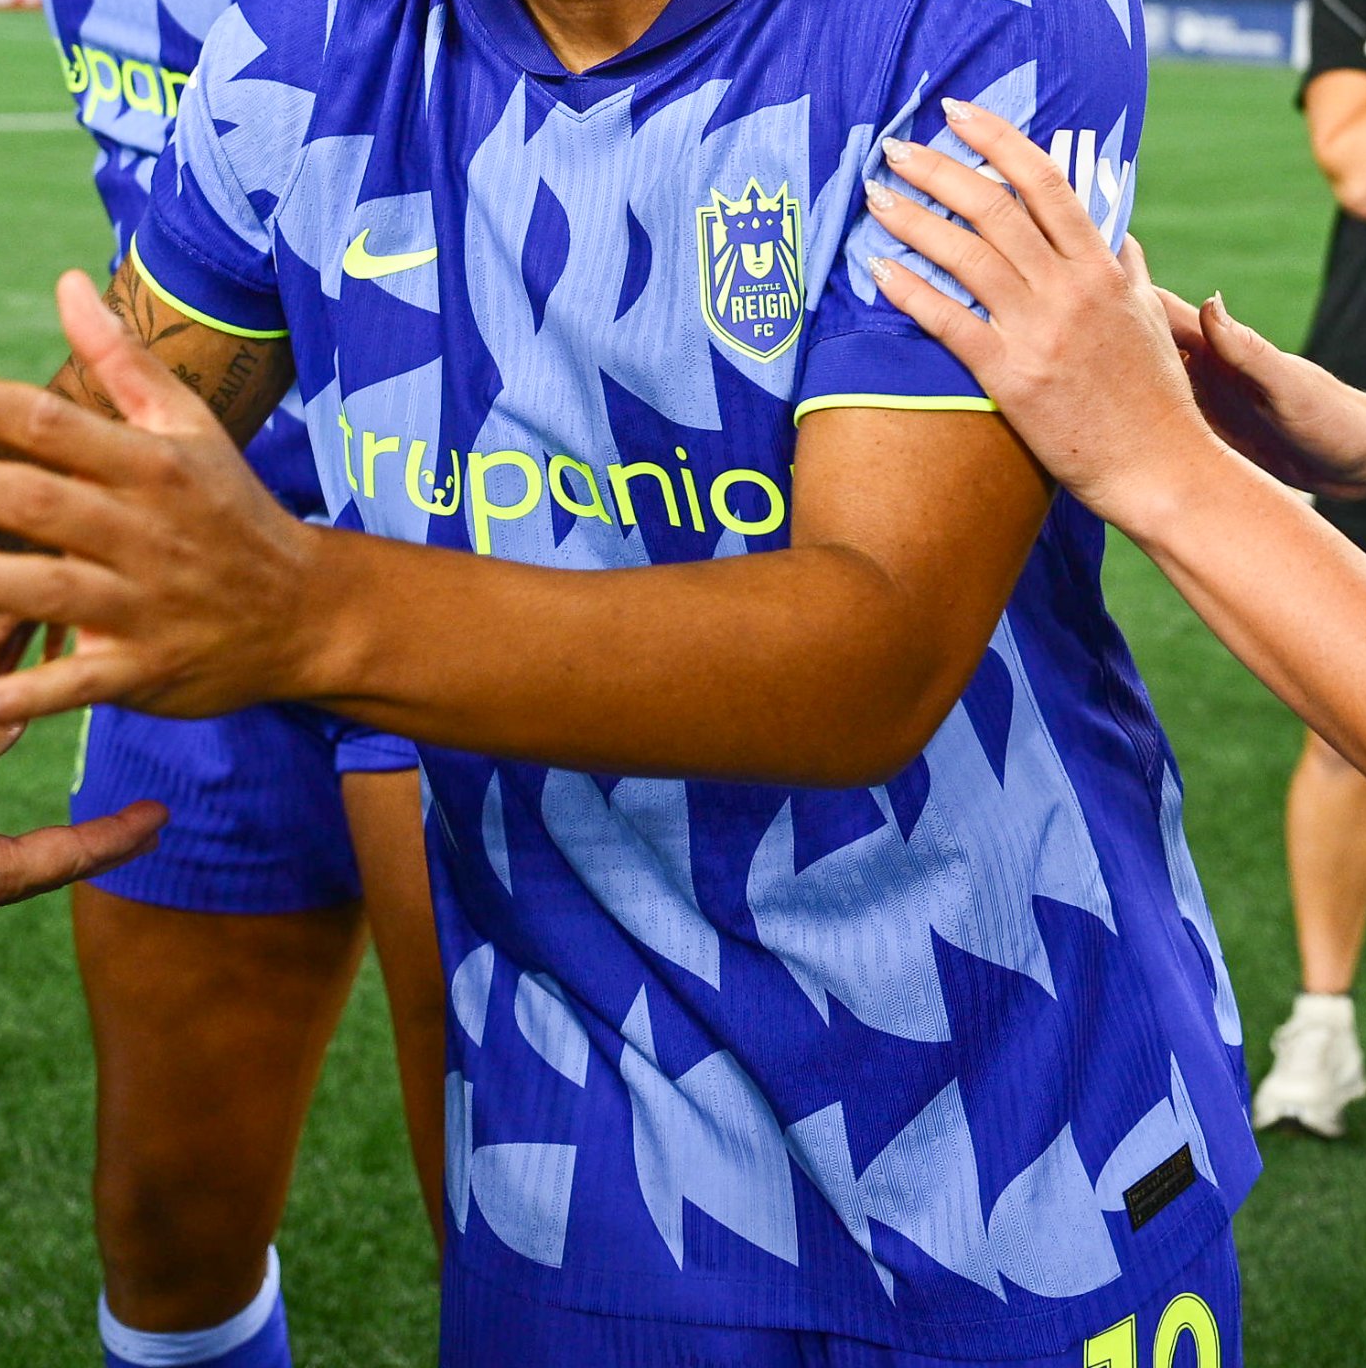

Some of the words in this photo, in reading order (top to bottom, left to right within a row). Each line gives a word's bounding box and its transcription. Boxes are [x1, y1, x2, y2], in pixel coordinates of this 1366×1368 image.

[739, 283, 781, 292] SEATTLE
[730, 292, 792, 324] REIGN
[753, 323, 775, 338] FC
[208, 343, 258, 420] EAUTY
[338, 404, 793, 555] trupanio
